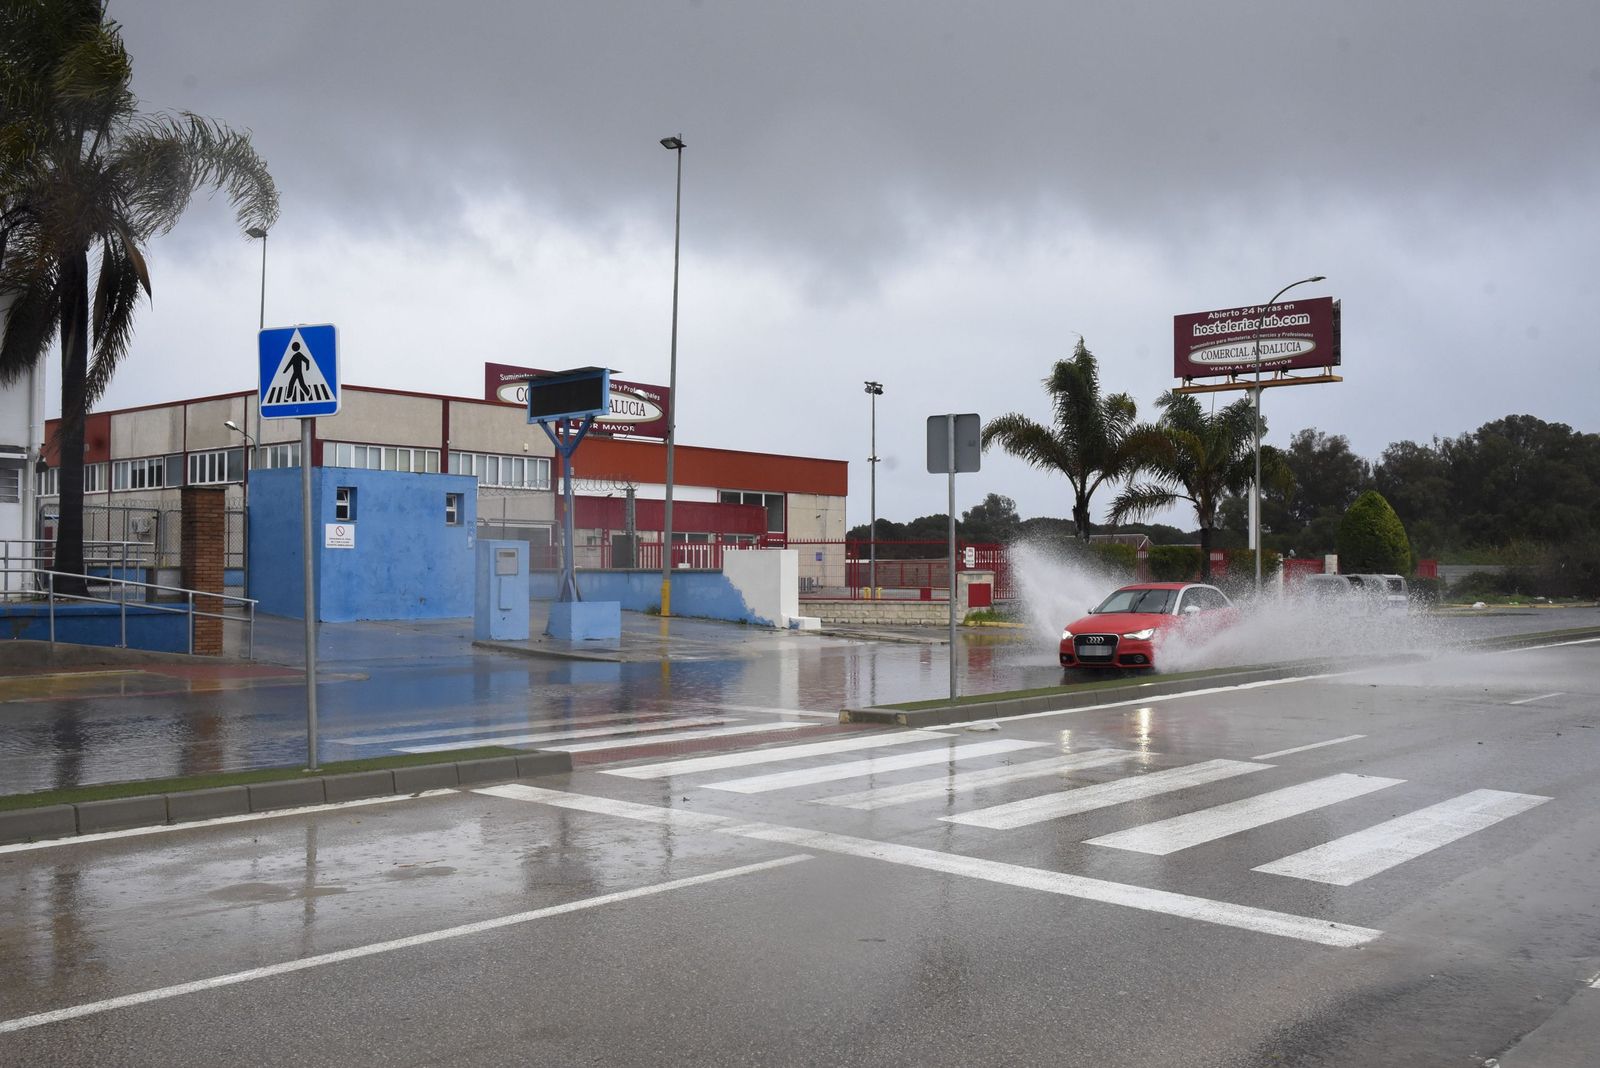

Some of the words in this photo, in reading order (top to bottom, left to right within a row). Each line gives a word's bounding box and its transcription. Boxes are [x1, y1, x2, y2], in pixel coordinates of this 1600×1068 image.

[1207, 309, 1240, 320] Abierto
[1241, 307, 1255, 316] 24
[1193, 312, 1311, 337] hosteleriaclub.com
[1201, 346, 1250, 361] COMERCIAL
[1251, 341, 1302, 356] ANDALUCIA
[1265, 359, 1293, 367] MAYOR
[602, 423, 635, 432] MAYOR
